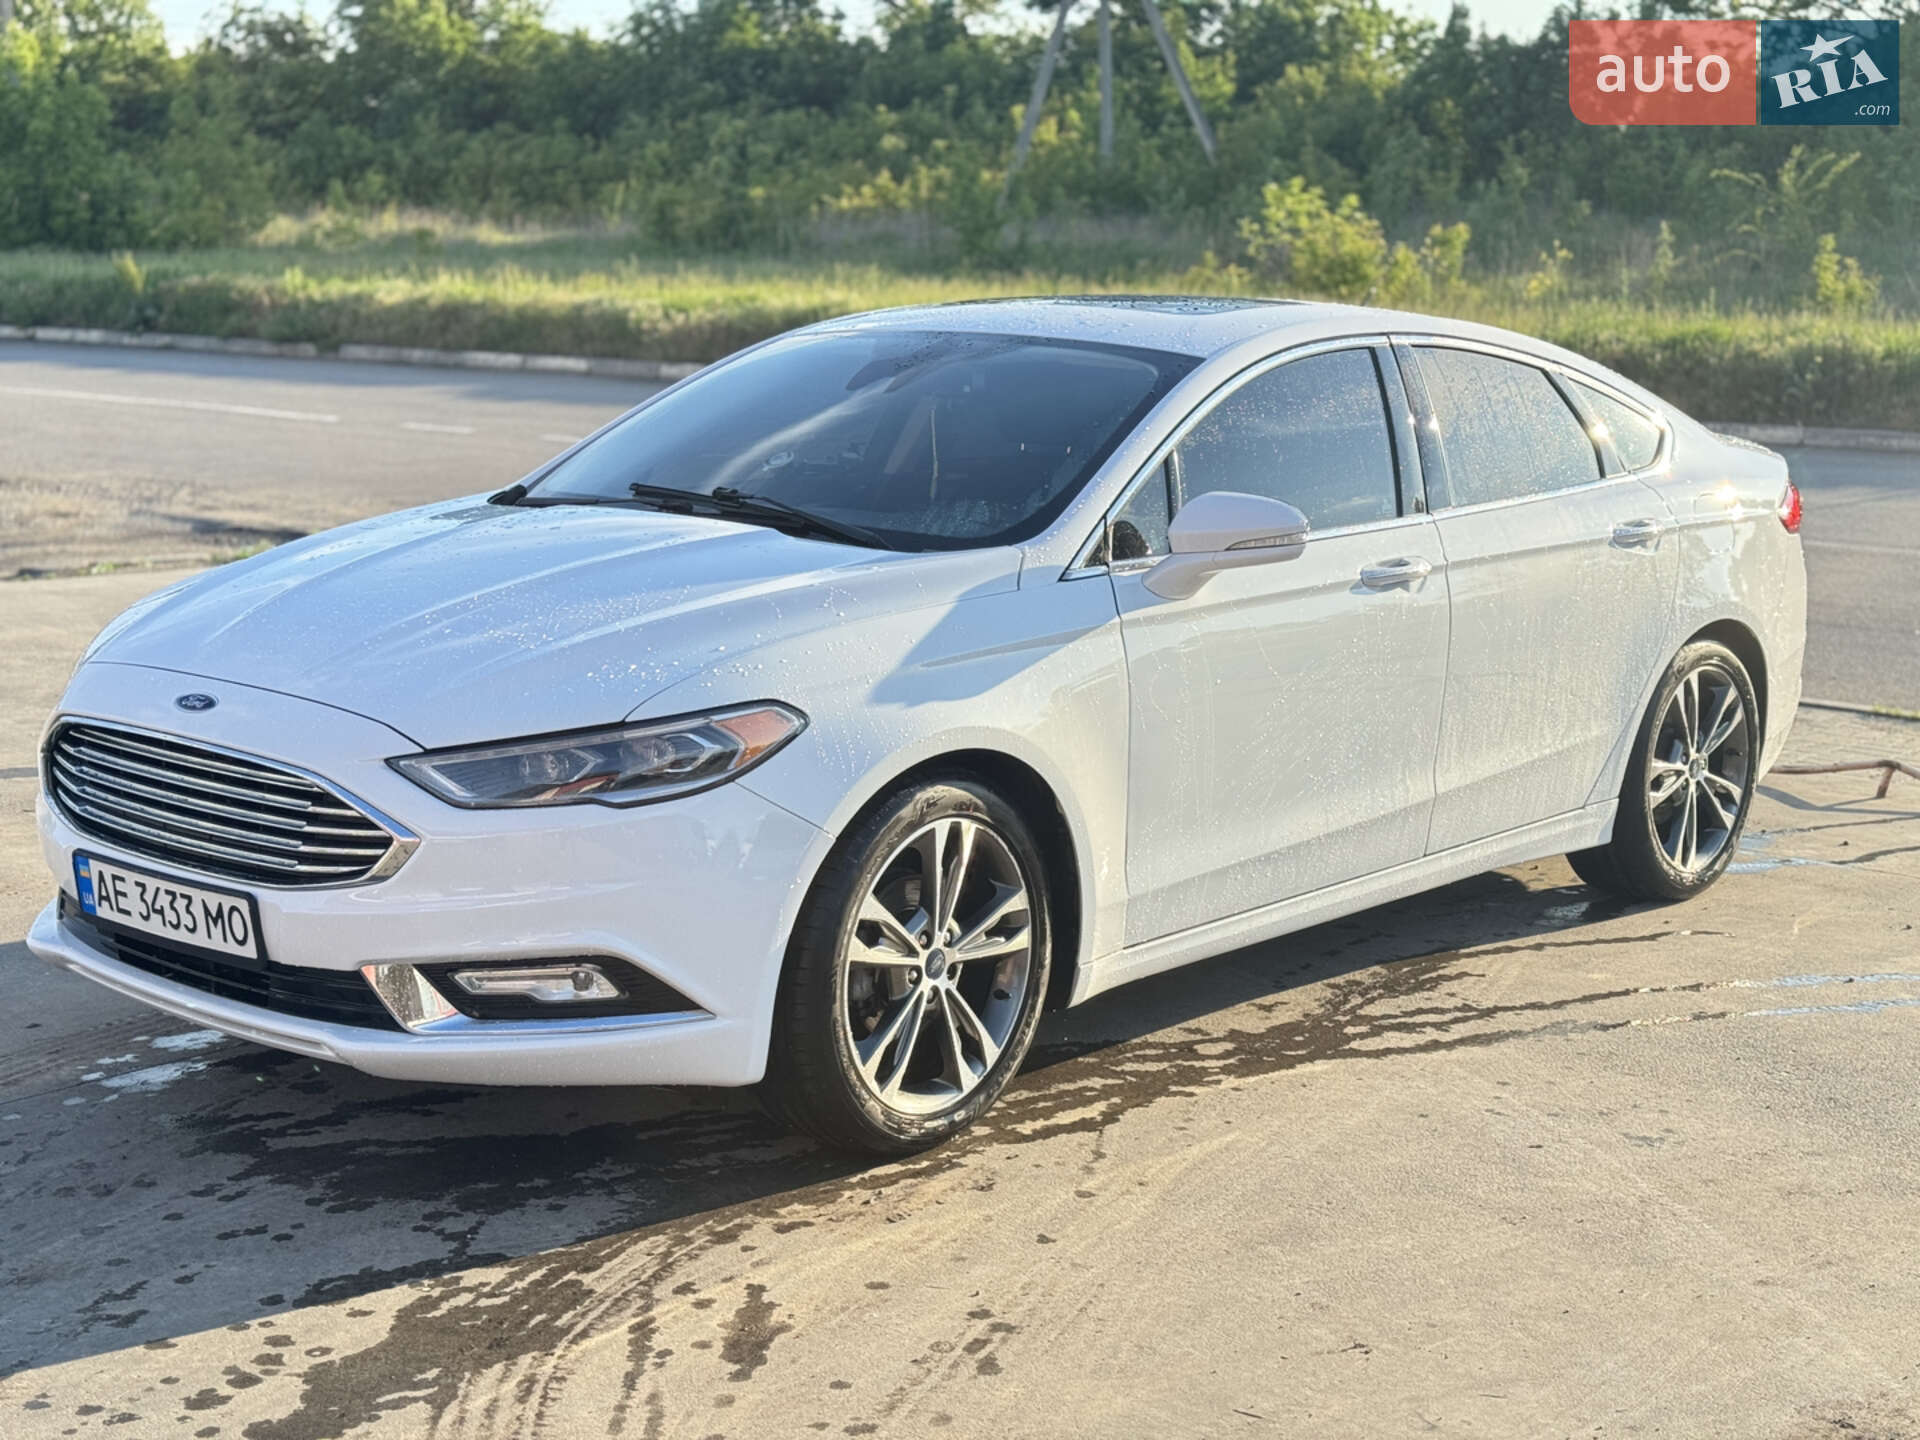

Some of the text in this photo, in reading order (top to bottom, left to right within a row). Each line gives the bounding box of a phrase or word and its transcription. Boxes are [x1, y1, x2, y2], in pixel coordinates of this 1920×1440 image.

[98, 870, 249, 947] AE 3433 MO
